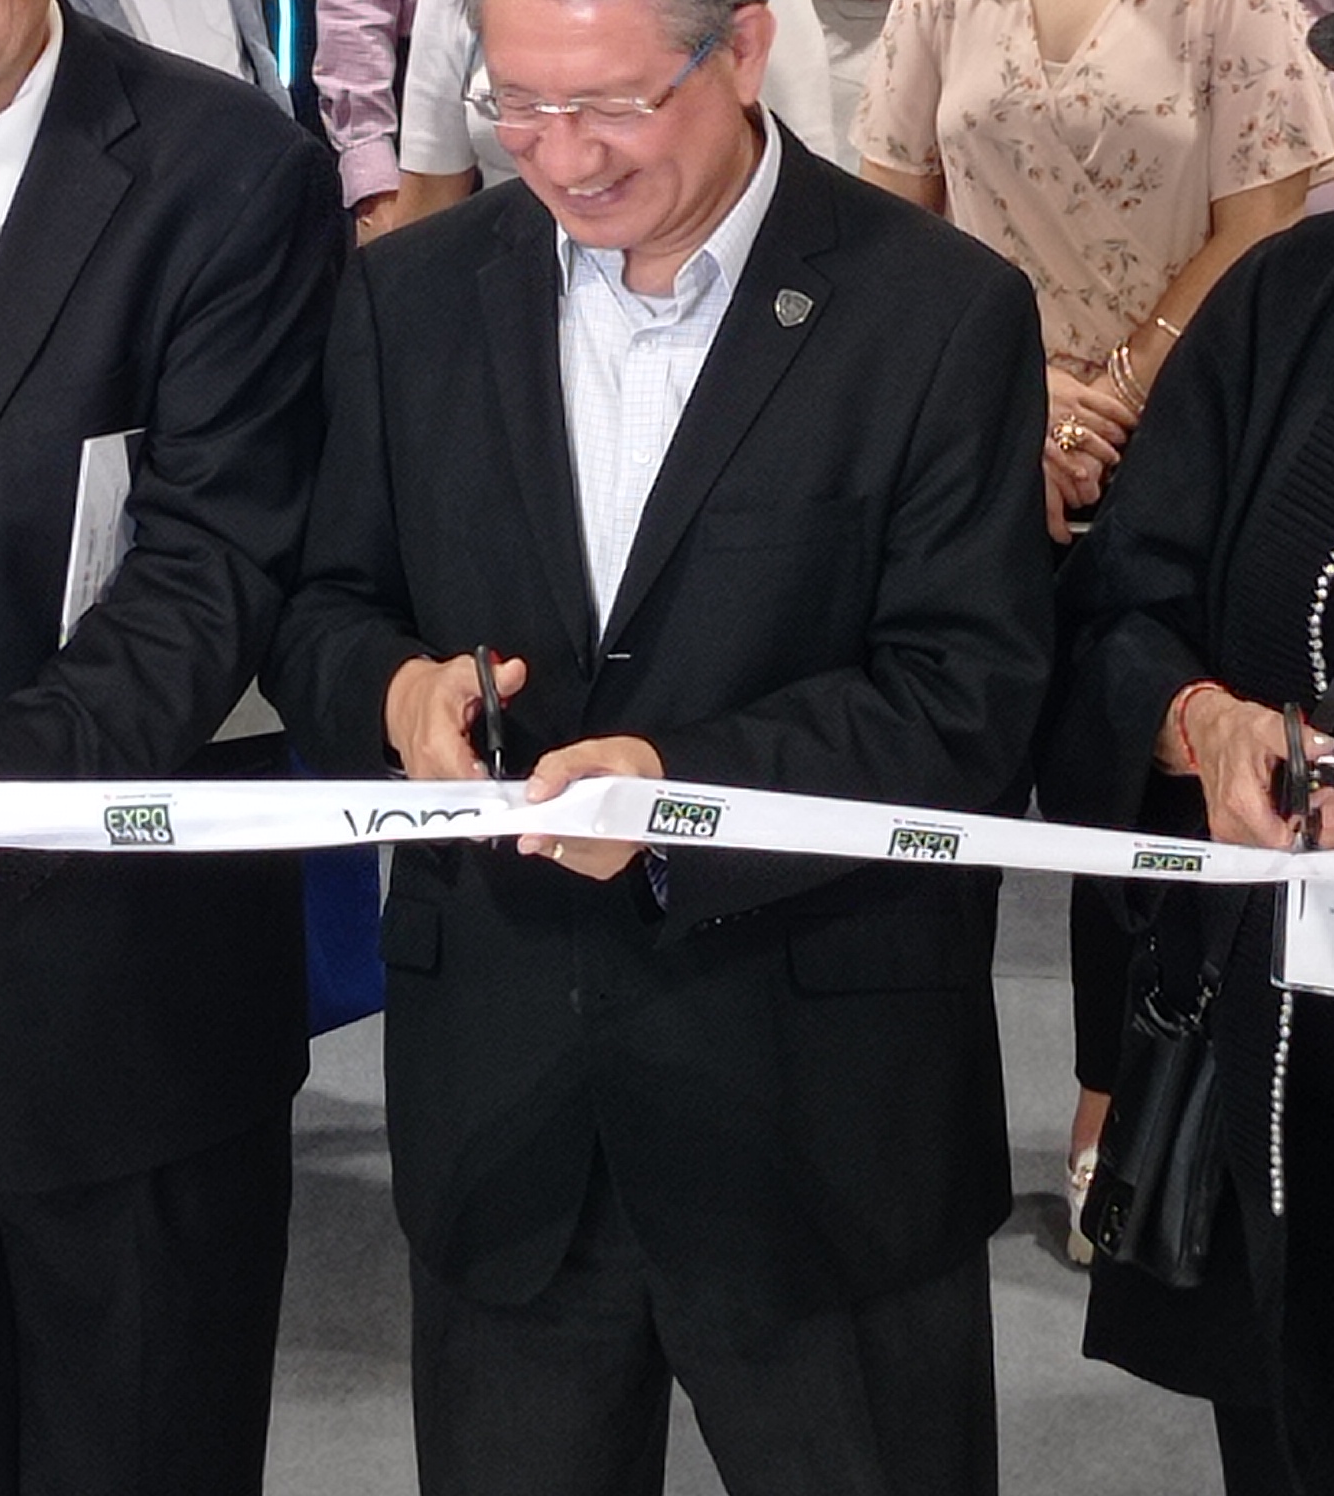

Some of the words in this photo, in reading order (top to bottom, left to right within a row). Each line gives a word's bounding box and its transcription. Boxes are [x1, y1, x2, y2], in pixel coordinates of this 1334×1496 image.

[107, 808, 166, 828] EXPO
[657, 801, 717, 822] EXPO
[653, 815, 712, 837] MRO
[897, 830, 956, 851] EXPO
